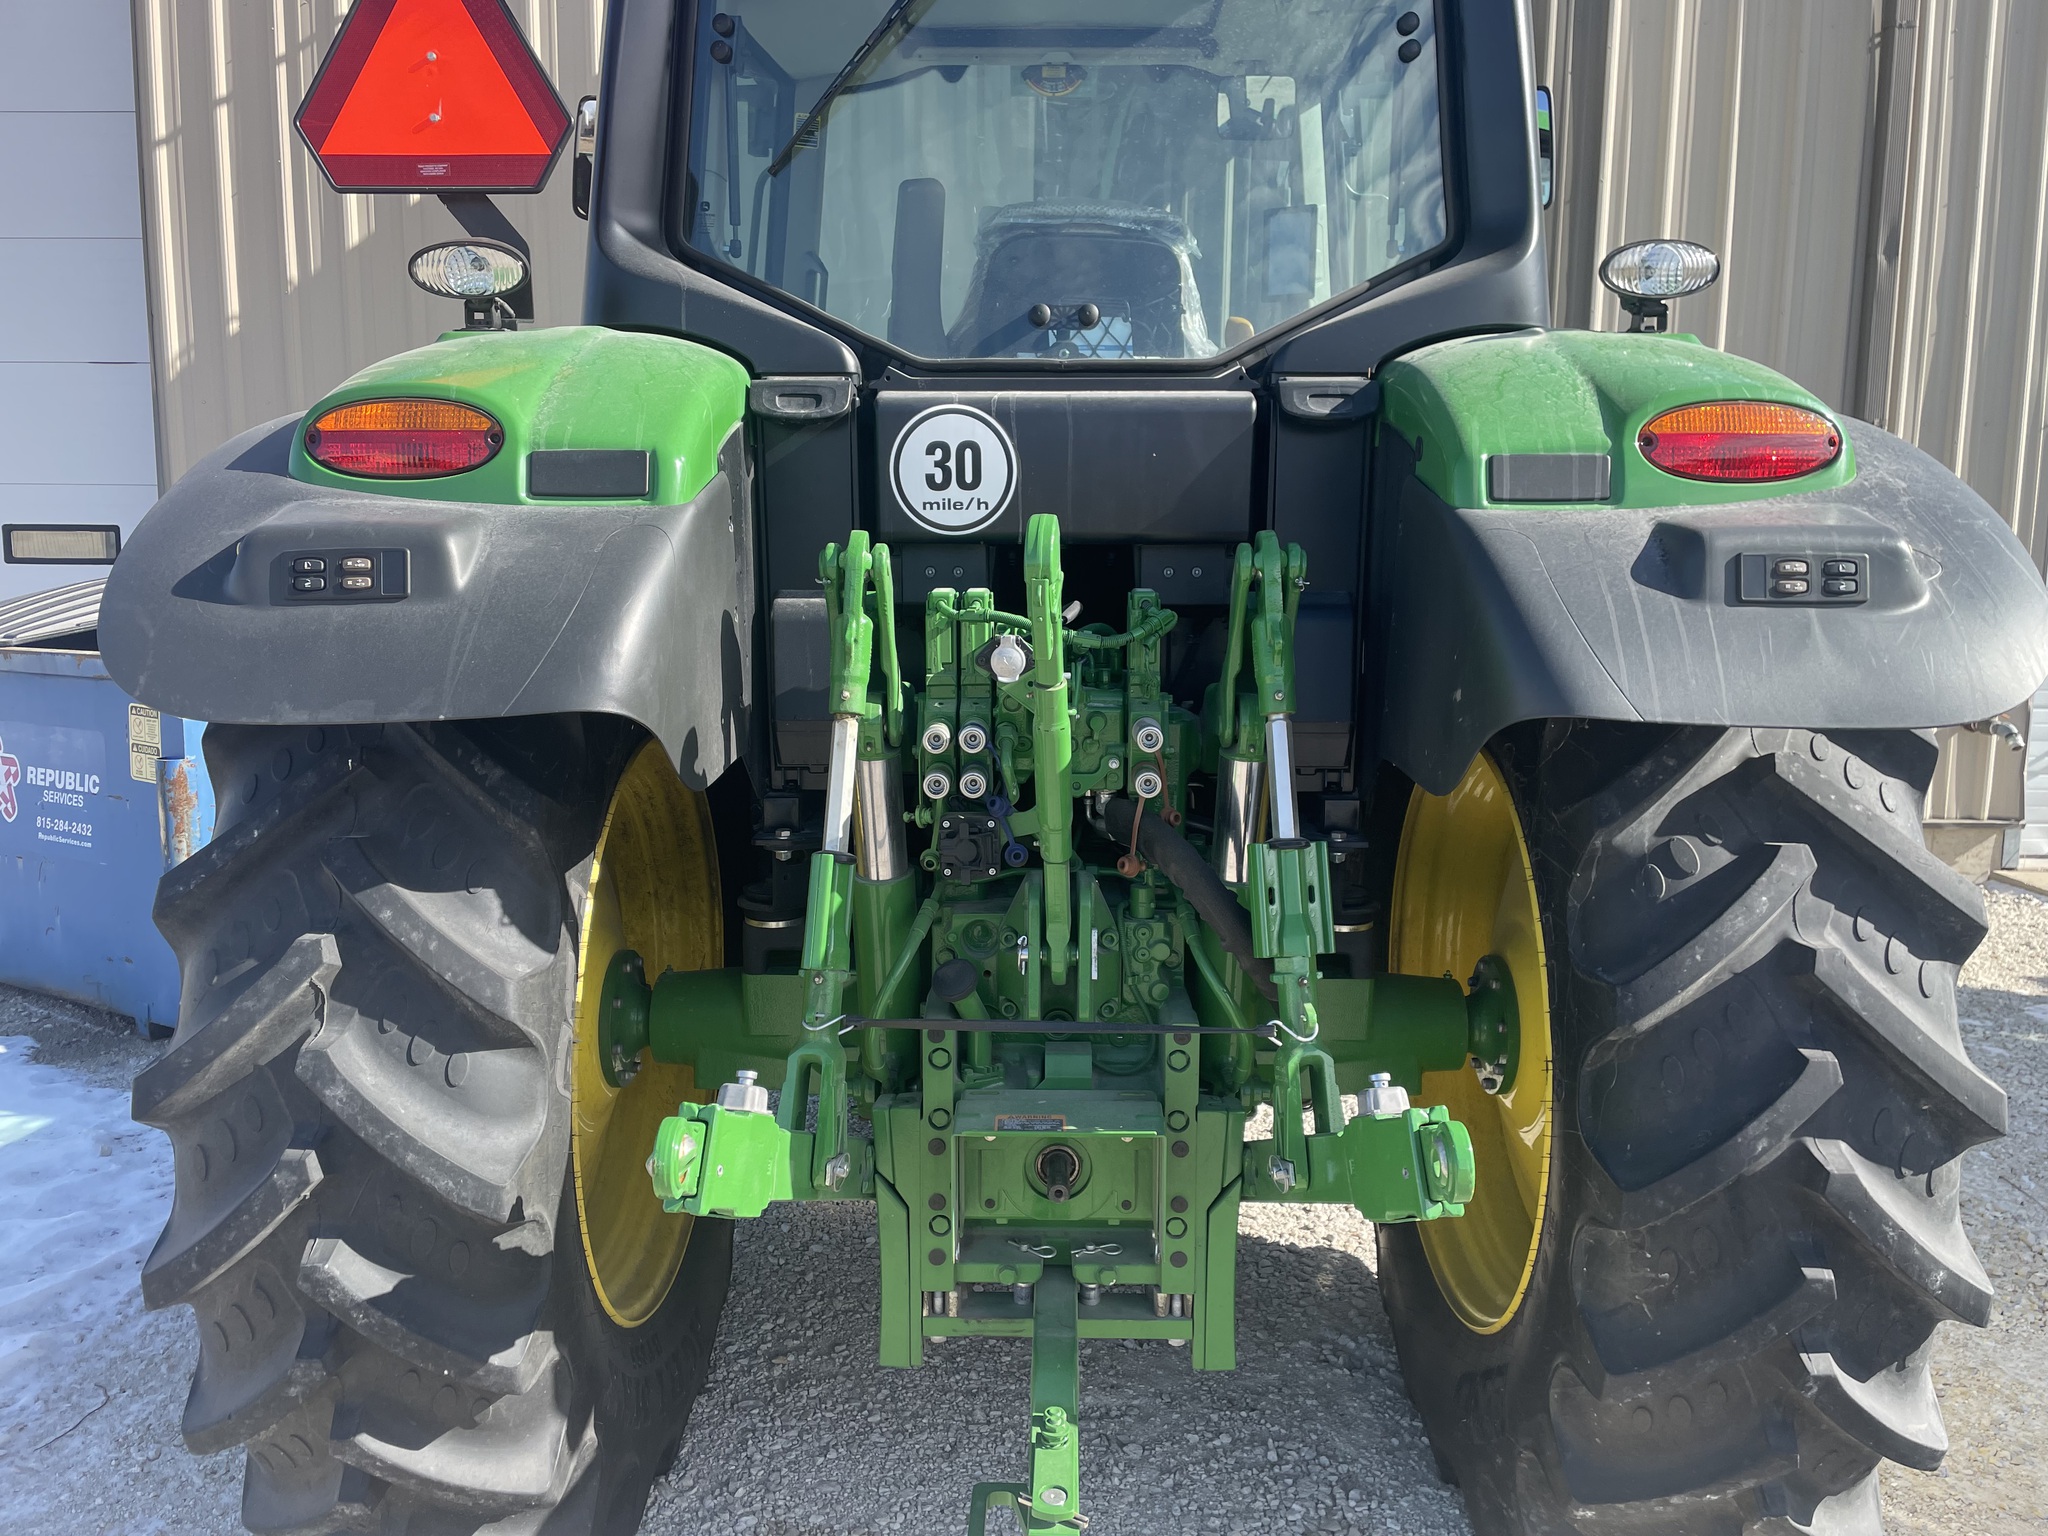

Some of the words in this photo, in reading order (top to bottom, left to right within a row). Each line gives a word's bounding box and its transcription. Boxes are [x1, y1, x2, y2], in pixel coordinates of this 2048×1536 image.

[925, 440, 982, 491] 30
[922, 496, 989, 511] mile/h
[136, 707, 158, 718] CAUTION
[138, 744, 158, 755] CUIDADO
[27, 766, 100, 794] REPUBLIC
[42, 790, 84, 808] SERVICES
[36, 816, 93, 837] 815-284-2432
[38, 832, 92, 848] RepublicServices.com
